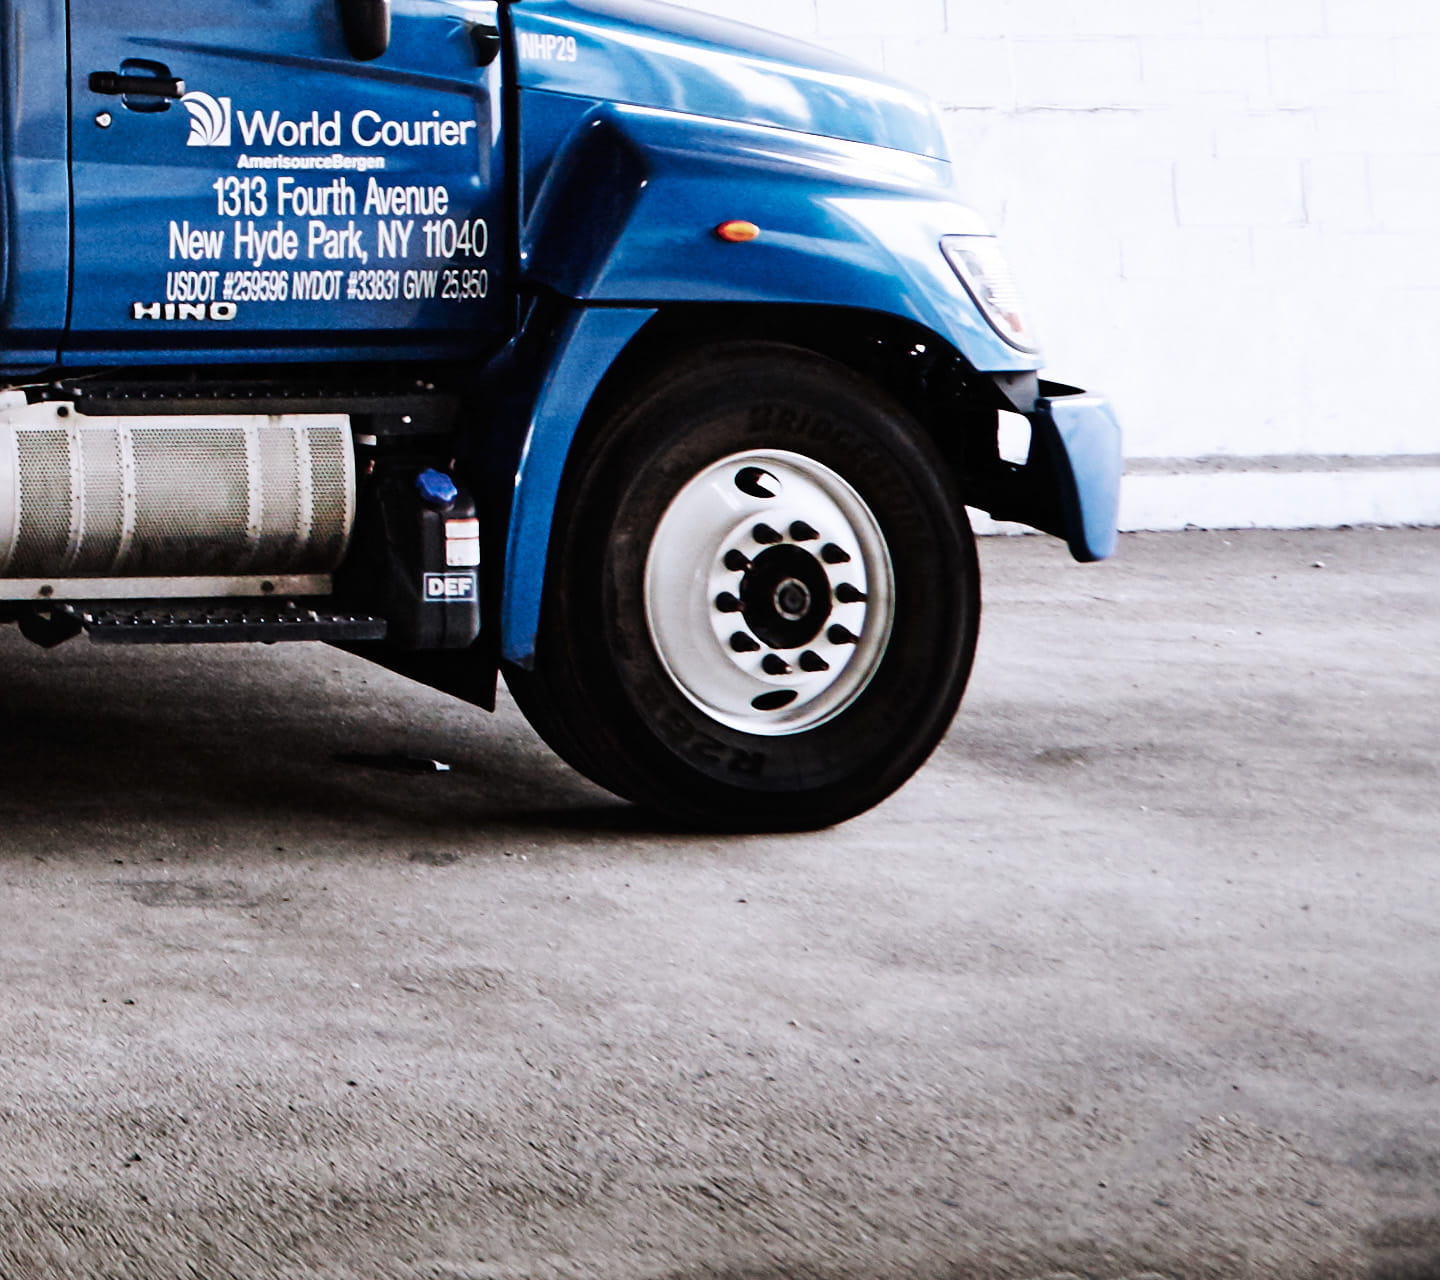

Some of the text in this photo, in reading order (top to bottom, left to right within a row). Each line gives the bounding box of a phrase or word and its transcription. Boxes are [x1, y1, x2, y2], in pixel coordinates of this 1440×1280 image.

[519, 31, 577, 63] NHP29
[236, 109, 477, 147] World Courier
[236, 153, 386, 173] AmerisourceBergen
[212, 175, 450, 217] 1313 Fourth Avenue
[168, 217, 489, 268] New Hyde Park, NY 11040
[165, 268, 489, 304] USDOT #259596 NYDOT #33831 GVW 25,950
[132, 301, 239, 321] HINO
[427, 577, 473, 597] DEF
